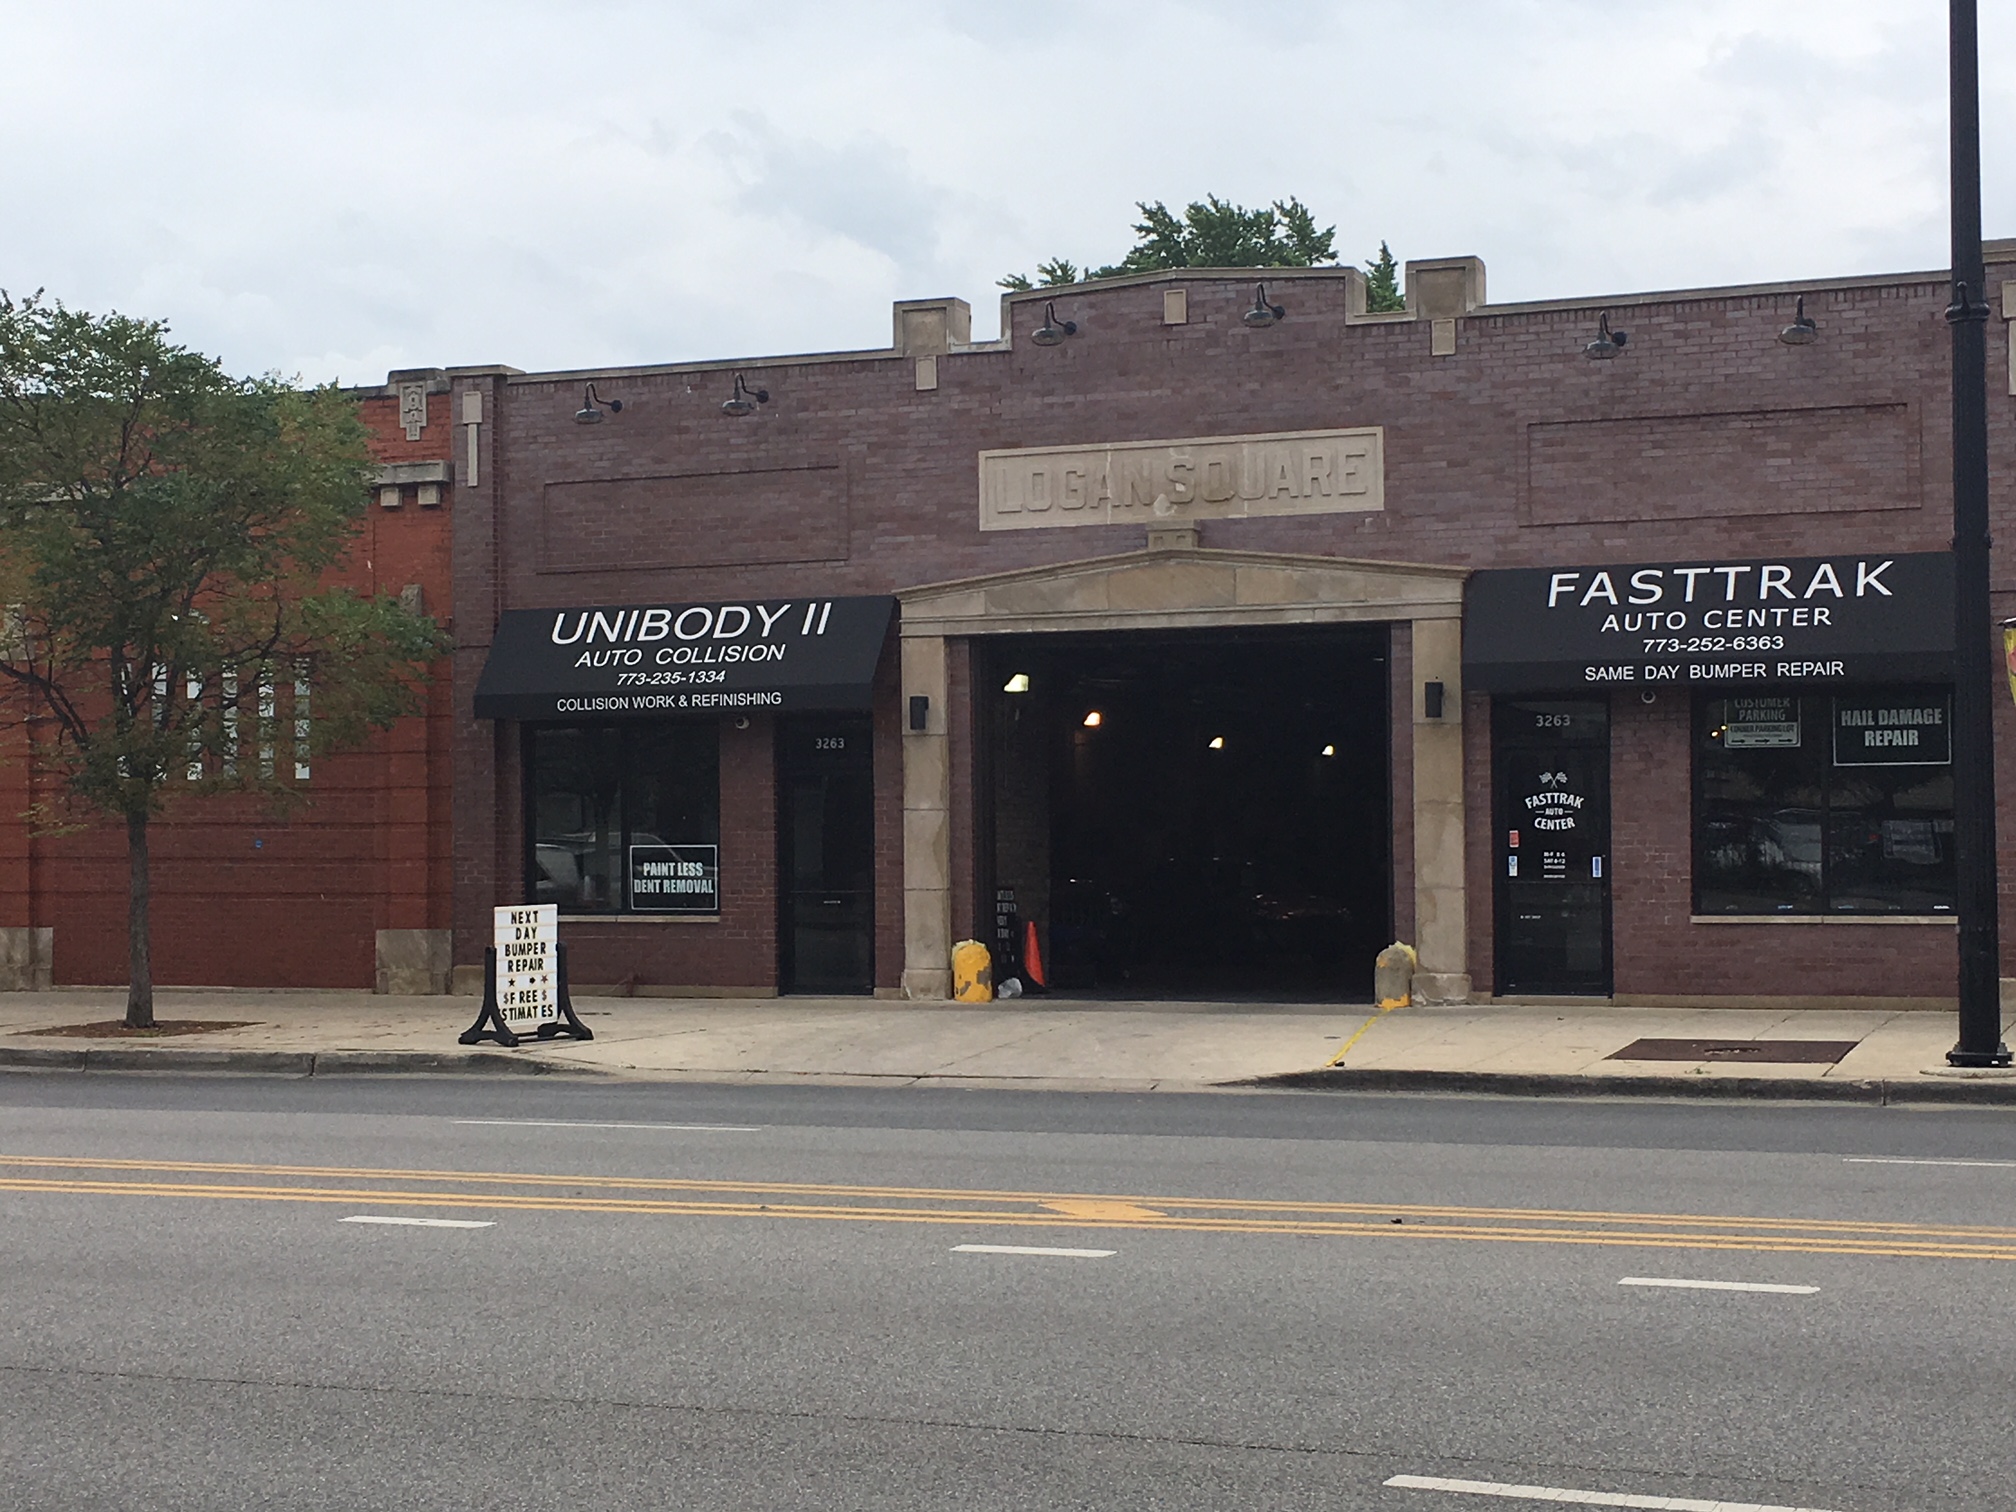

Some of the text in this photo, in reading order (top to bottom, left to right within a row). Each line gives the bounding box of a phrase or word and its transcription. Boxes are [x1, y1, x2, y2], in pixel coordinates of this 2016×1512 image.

[994, 445, 1370, 514] LOGAN SQUARE
[1547, 560, 1895, 608] FASTTRAK
[551, 602, 833, 646] UNIBODY II
[1600, 607, 1833, 633] AUTO CENTER
[1642, 635, 1785, 654] 773-252-6363
[574, 643, 787, 669] AUTO COLLISION
[616, 670, 726, 687] 773-235-1334
[1584, 661, 1846, 682] SAME DAY BUMPER REPAIR
[556, 691, 783, 712] COLLISION WORK & REFINISHING
[1535, 714, 1571, 728] 3263
[1738, 708, 1786, 721] PARKING
[1841, 708, 1943, 726] HAIL DAMAGE
[815, 737, 845, 749] 3263
[1864, 729, 1919, 747] REPAIR
[1524, 792, 1585, 809] FASTTRAK
[1544, 807, 1564, 816] AUTO
[1534, 817, 1576, 830] CENTER
[643, 862, 704, 876] PAINT LESS
[633, 879, 714, 893] DENT REMOVAL
[510, 910, 539, 925] NEXT
[515, 926, 538, 940] DAY
[504, 942, 547, 957] BUMPER
[507, 958, 544, 973] REPAIR
[499, 1004, 554, 1021] STIMATES
